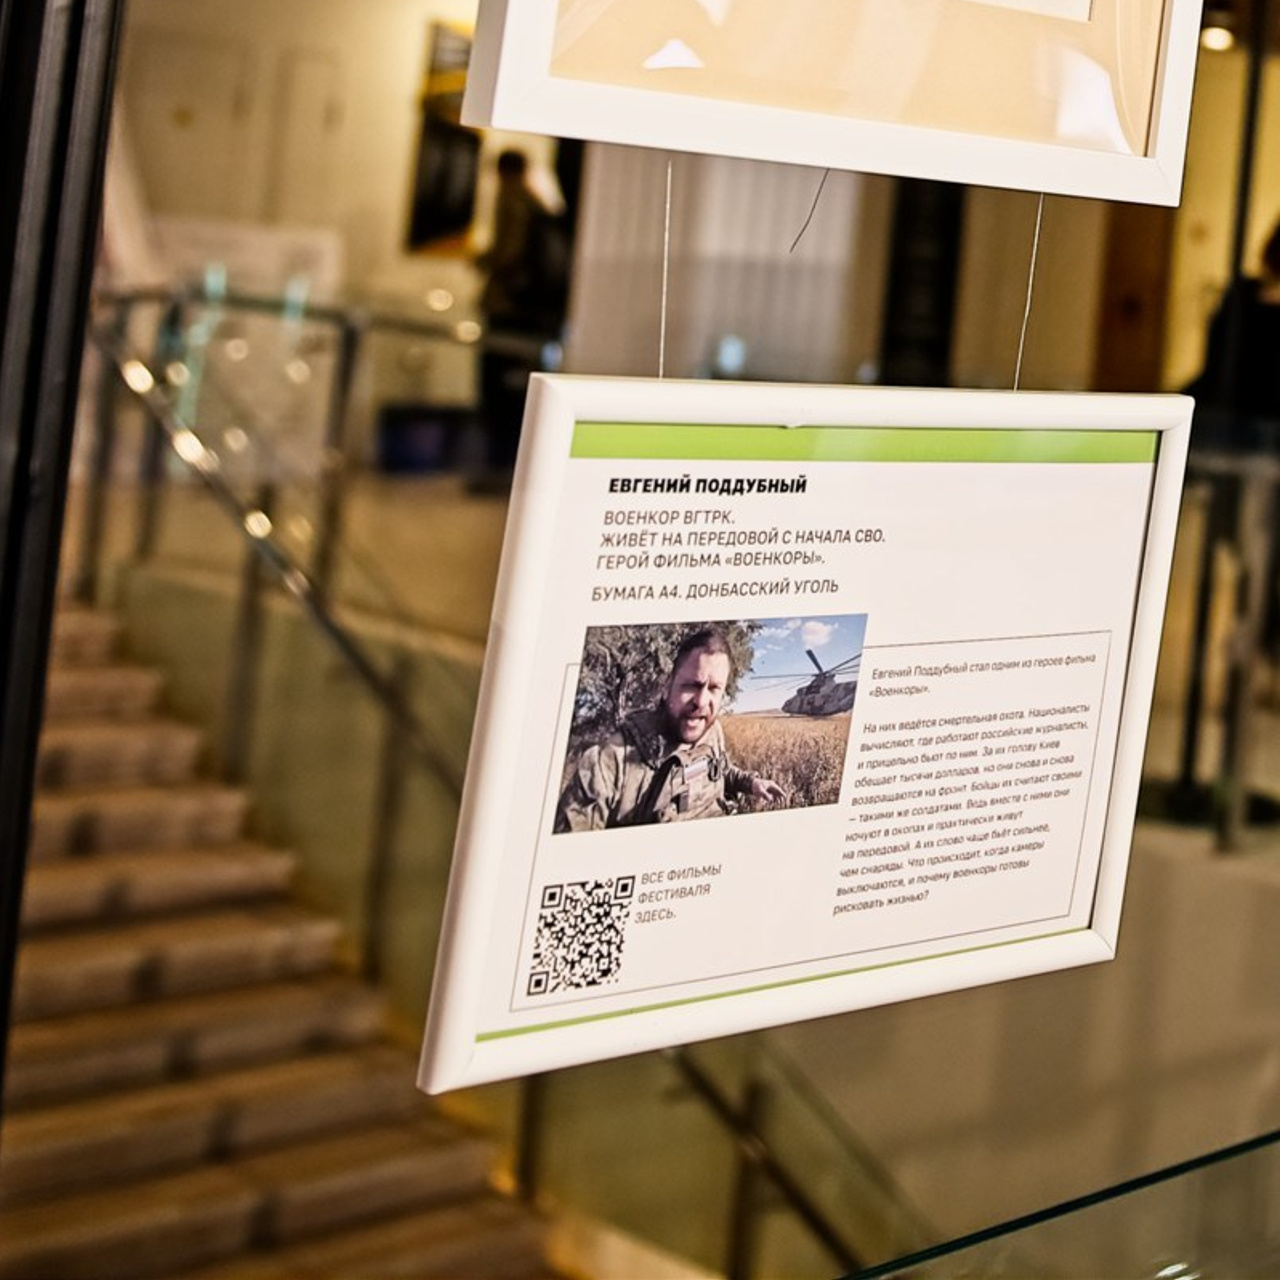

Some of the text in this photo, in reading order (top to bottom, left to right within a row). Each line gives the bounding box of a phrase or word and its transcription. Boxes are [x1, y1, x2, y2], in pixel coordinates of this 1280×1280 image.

[608, 474, 807, 496] ЕВГЕНИЙ ПОДДУБНЫЙ
[603, 509, 735, 526] ВОЕНКОР ВГТРК.
[600, 527, 885, 548] ЖИВЁТ НА ПЕРЕДОВОЙ С НАЧАЛА СВО.
[596, 550, 825, 570] ГЕРОЙ ФИЛЬМА «ВОЕНКОРЫ».
[591, 577, 839, 602] БУМАГА А4. ДОНБАССКИЙ УГОЛЬ
[641, 865, 721, 884] ВСЕ ФИЛЬМЫ
[638, 884, 711, 904] ФЕСТИВАЛЯ
[635, 908, 676, 923] ЗДЕСЬ.
